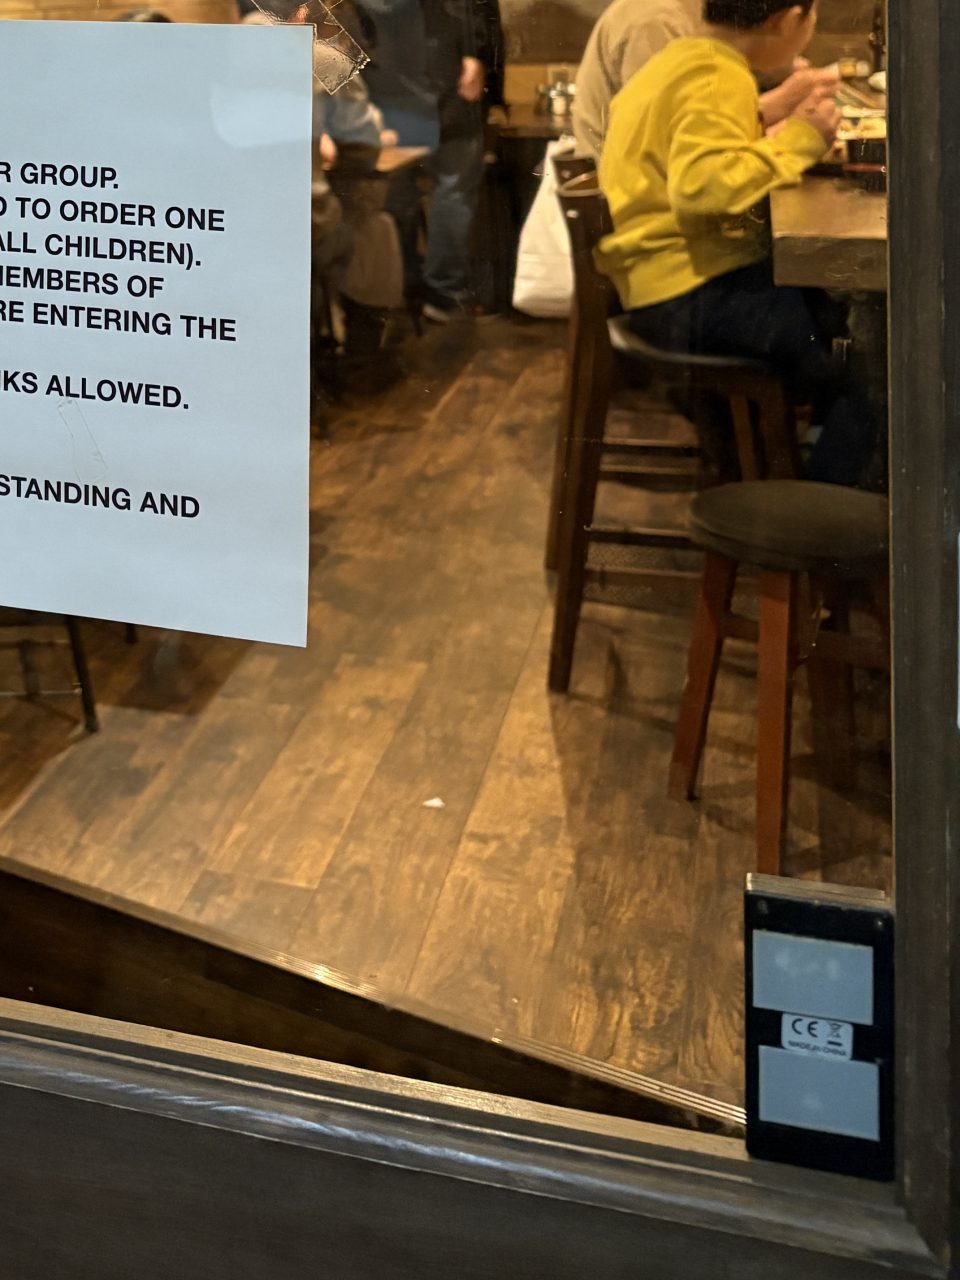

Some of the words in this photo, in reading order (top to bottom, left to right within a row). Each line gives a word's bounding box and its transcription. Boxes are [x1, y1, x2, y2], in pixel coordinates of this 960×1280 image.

[20, 162, 119, 190] GROUP.
[15, 196, 51, 220] TO
[59, 199, 156, 227] ORDER
[164, 206, 225, 232] ONE
[44, 233, 199, 272] CHILDREN).
[126, 274, 165, 299] OF
[33, 302, 172, 336] ENTERING
[179, 314, 237, 342] THE
[45, 374, 187, 409] ALLOWED.
[139, 491, 200, 518] AND
